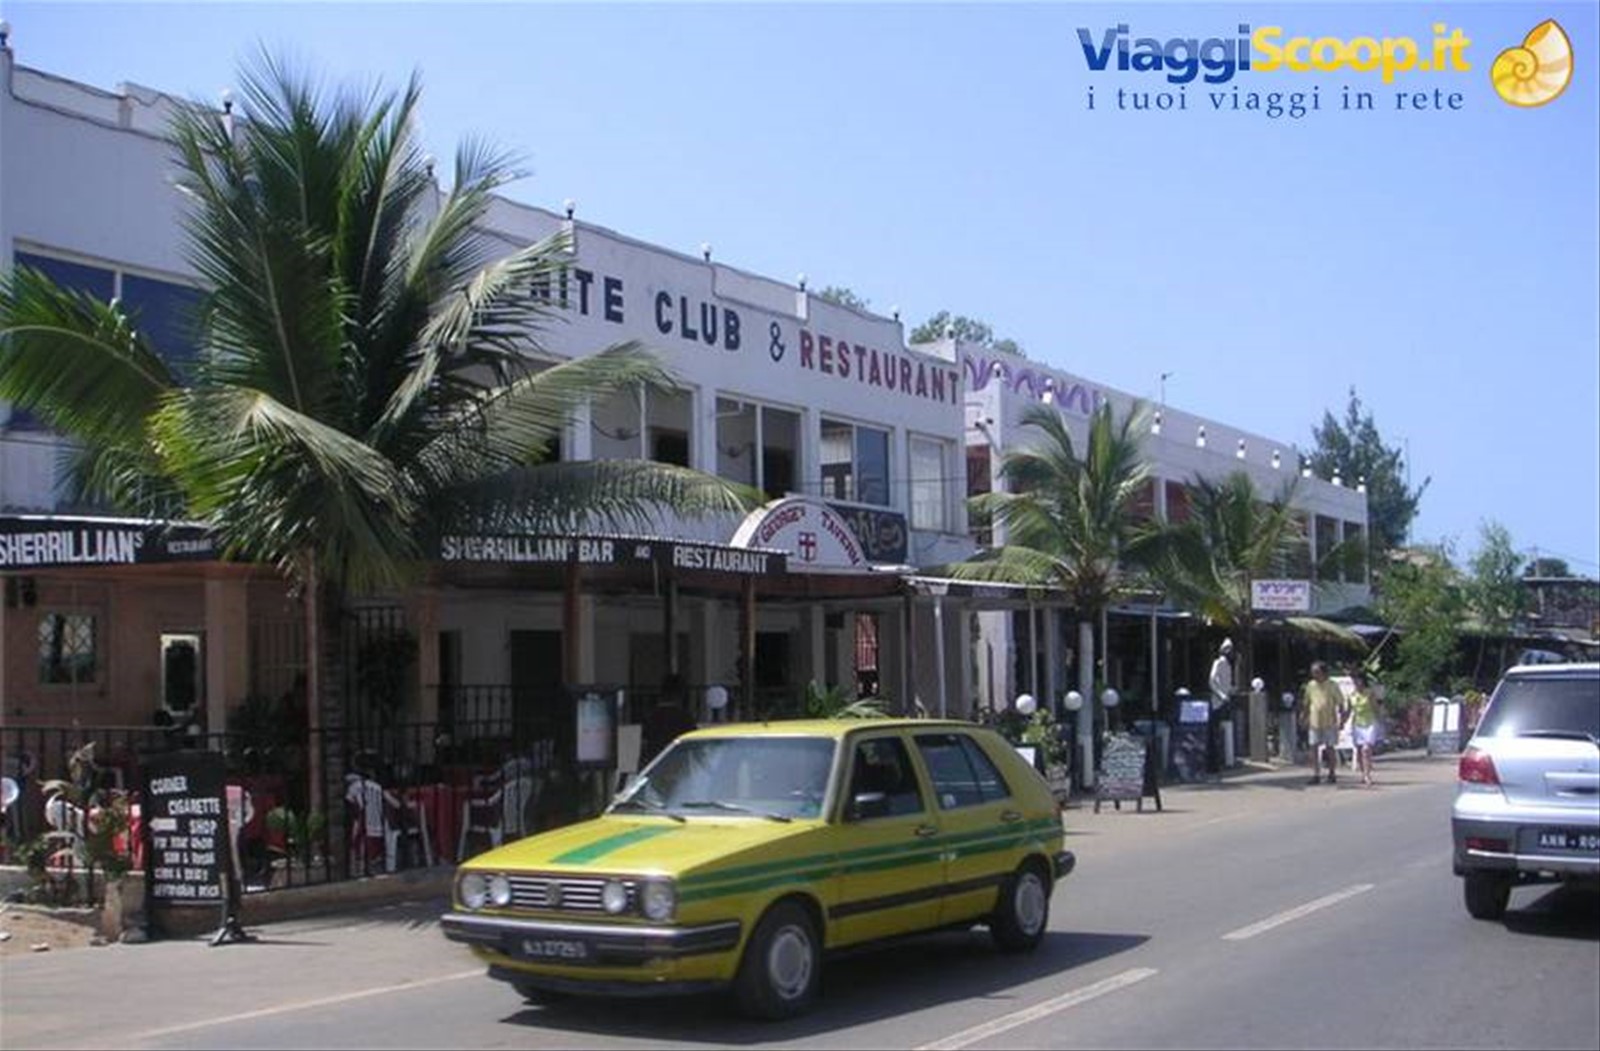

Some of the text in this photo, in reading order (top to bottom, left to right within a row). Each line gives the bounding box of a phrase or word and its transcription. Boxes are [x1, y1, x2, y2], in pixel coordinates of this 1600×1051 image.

[655, 290, 741, 351] CLUB
[769, 321, 785, 362] &
[800, 329, 959, 405] RESTAURANT
[578, 541, 614, 563] BAR
[673, 545, 768, 574] RESTAURANT
[168, 798, 221, 815] CIGARETTE
[189, 819, 218, 836] SHOP
